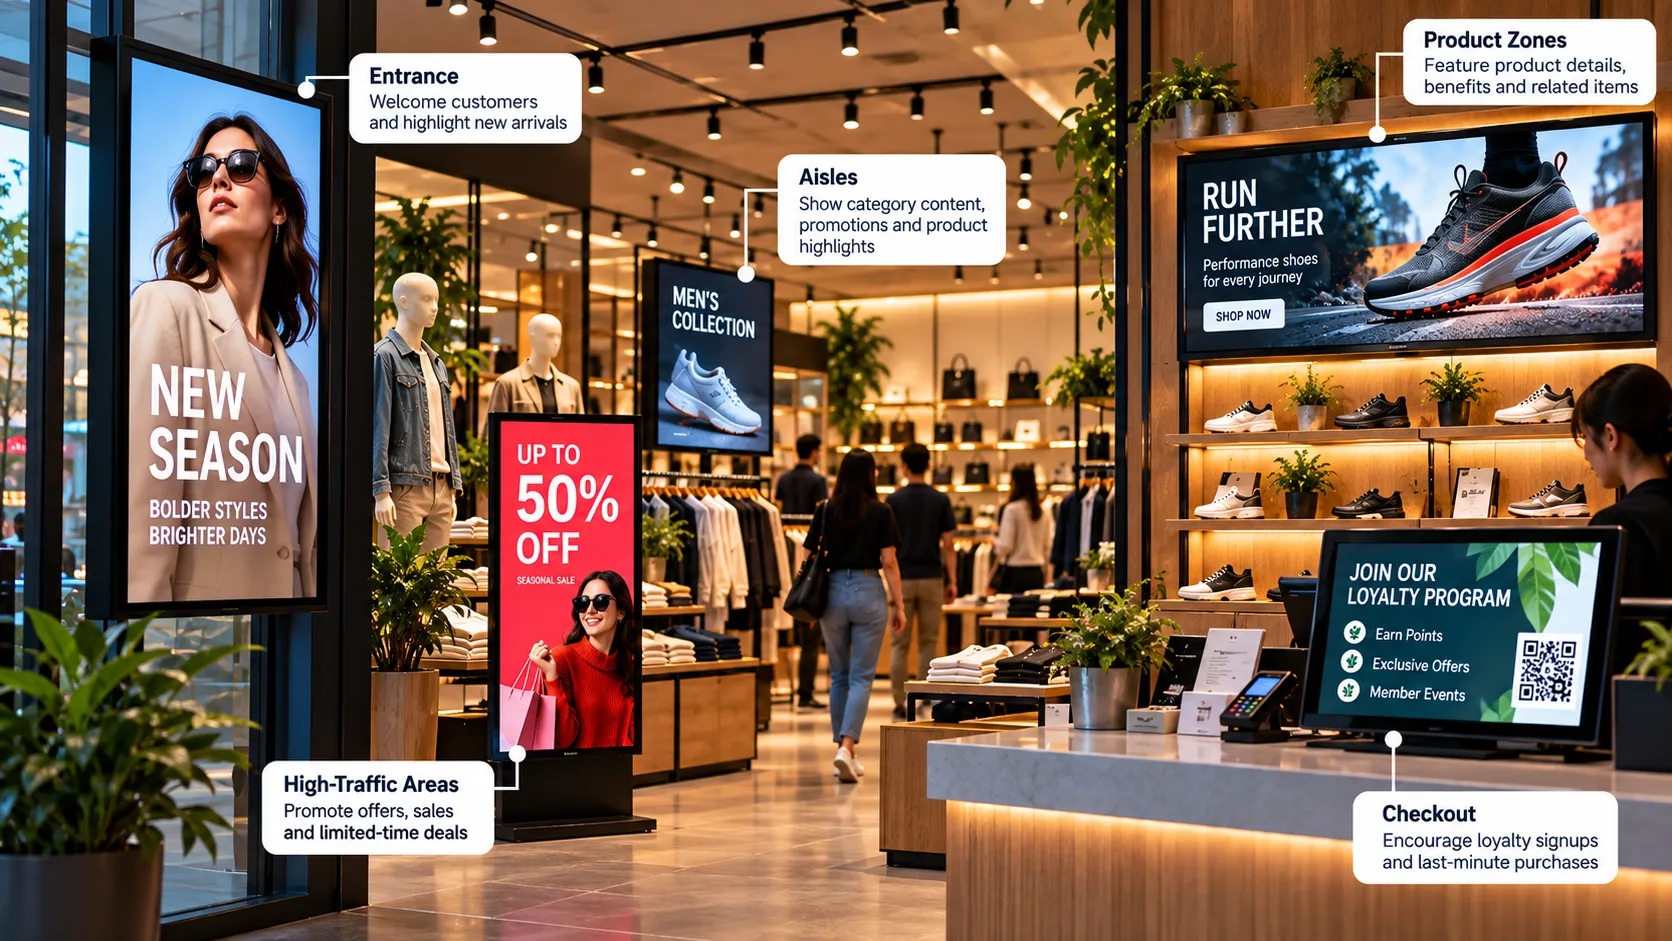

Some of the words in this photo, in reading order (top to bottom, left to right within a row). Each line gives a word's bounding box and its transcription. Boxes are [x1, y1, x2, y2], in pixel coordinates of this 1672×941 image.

[1203, 178, 1257, 211] RUN
[1203, 207, 1324, 244] FURTHER
[1203, 256, 1280, 272] Performance
[1282, 253, 1319, 267] shoes
[1202, 274, 1221, 288] for
[1222, 275, 1256, 289] every
[1257, 271, 1303, 288] journey
[673, 285, 719, 311] MEN'S
[672, 310, 755, 339] COLLECTION
[1215, 310, 1244, 323] SHOP
[1246, 308, 1272, 321] NOW
[151, 363, 246, 421] NEW
[149, 426, 303, 484] SEASON
[517, 443, 547, 465] UP
[551, 443, 581, 465] TO
[516, 474, 619, 523] 50%
[149, 499, 211, 519] BOLDER
[214, 500, 268, 520] STYLES
[149, 525, 226, 545] BRIGHTER
[230, 526, 267, 545] DAYS
[516, 531, 580, 565] OFF
[516, 576, 555, 585] SEASONAL
[556, 576, 575, 585] SALE
[1349, 562, 1393, 582] JOIN
[1397, 563, 1437, 582] OUR
[1347, 587, 1421, 606] LOYALTY
[1423, 587, 1511, 607] PROGRAM
[1375, 627, 1403, 641] Earn
[1405, 628, 1443, 642] Points
[1372, 657, 1429, 672] Exclusive
[1432, 659, 1470, 674] Offers
[1369, 685, 1421, 700] Member
[1424, 687, 1466, 702] Events
